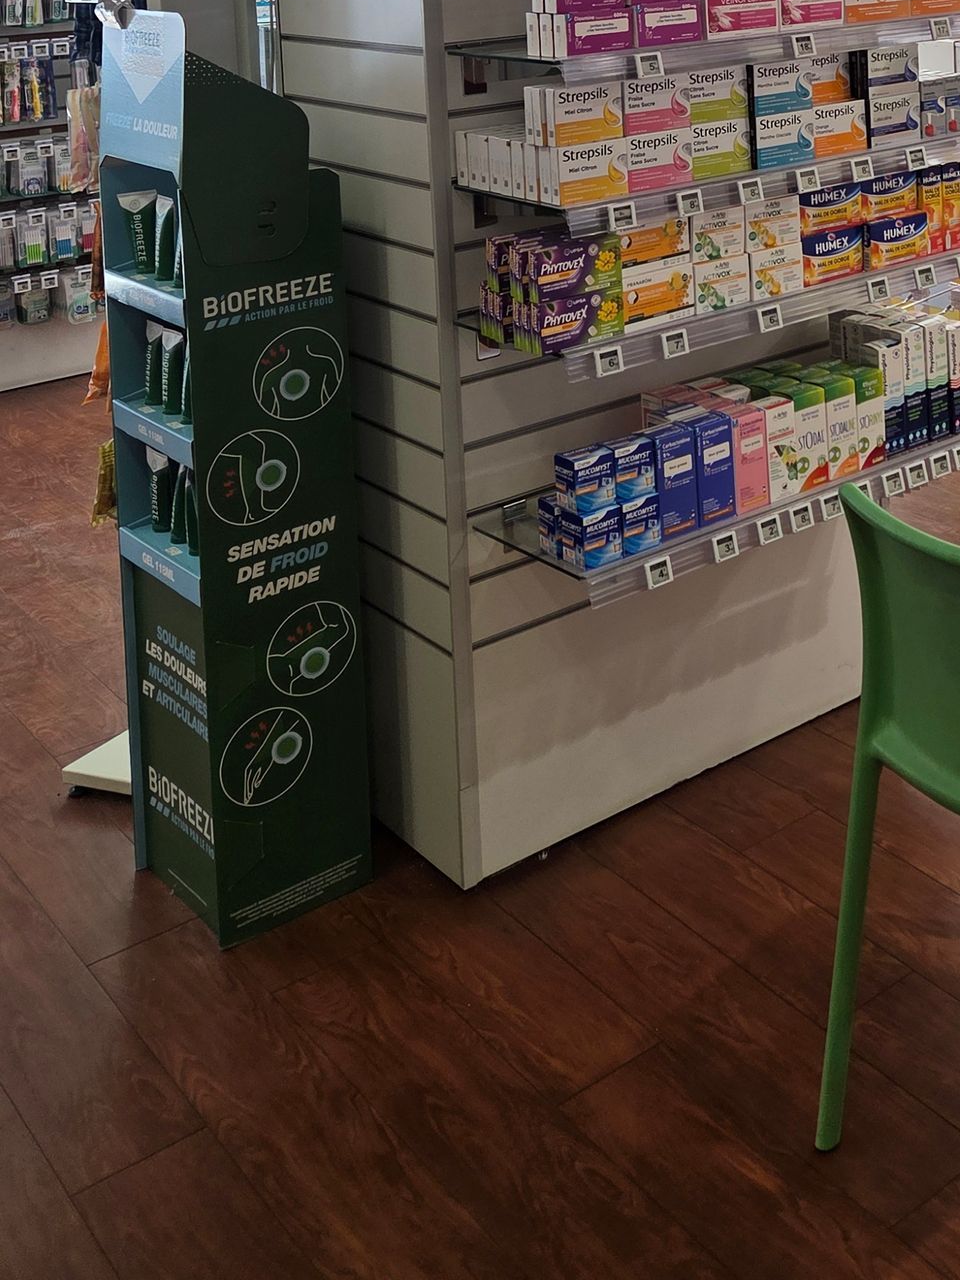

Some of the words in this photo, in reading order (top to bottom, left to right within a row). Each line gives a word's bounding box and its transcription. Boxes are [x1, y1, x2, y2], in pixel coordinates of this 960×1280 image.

[870, 49, 908, 62] Strepsils
[689, 70, 734, 84] Strepsils
[757, 64, 799, 78] Strepsils
[628, 79, 676, 94] Strepsils
[558, 88, 608, 104] Strepsils
[874, 98, 910, 112] Strepsils
[815, 106, 854, 120] Strepsils
[133, 117, 142, 131] LA
[143, 119, 177, 139] DOULEUR
[693, 123, 737, 138] Strepsils
[760, 116, 801, 130] Strepsils
[630, 135, 678, 150] Strepsils
[563, 145, 612, 162] Strepsils
[922, 174, 941, 184] HUMEX
[942, 171, 960, 179] HUMEX
[872, 177, 904, 192] HUMEX
[811, 189, 846, 205] HUMEX
[753, 209, 781, 219] ACTIVOX
[700, 221, 726, 231] ACTIVOX
[884, 224, 916, 241] HUMEX
[816, 238, 848, 254] HUMEX
[541, 255, 584, 275] PHYTOVEX
[759, 257, 786, 267] ACTIVOX
[703, 270, 730, 281] ACTIVOX
[245, 309, 277, 322] ACTION
[279, 305, 295, 314] PAR
[309, 296, 334, 308] FROID
[544, 305, 588, 327] PHYTOVEX
[798, 430, 824, 450] STODAL
[618, 451, 650, 464] MUCOMYST
[578, 463, 612, 477] MUCOMYST
[626, 505, 657, 519] MUCOMYST
[586, 518, 619, 533] MUCOMYST
[227, 516, 336, 562] SENSATION
[236, 561, 266, 584] DE
[271, 541, 329, 572] FROID
[248, 565, 321, 604] RAPIDE
[146, 639, 163, 662] LES
[157, 626, 196, 666] SOULAGE
[142, 679, 155, 698] ET
[149, 662, 207, 719] MUSCULAIRES
